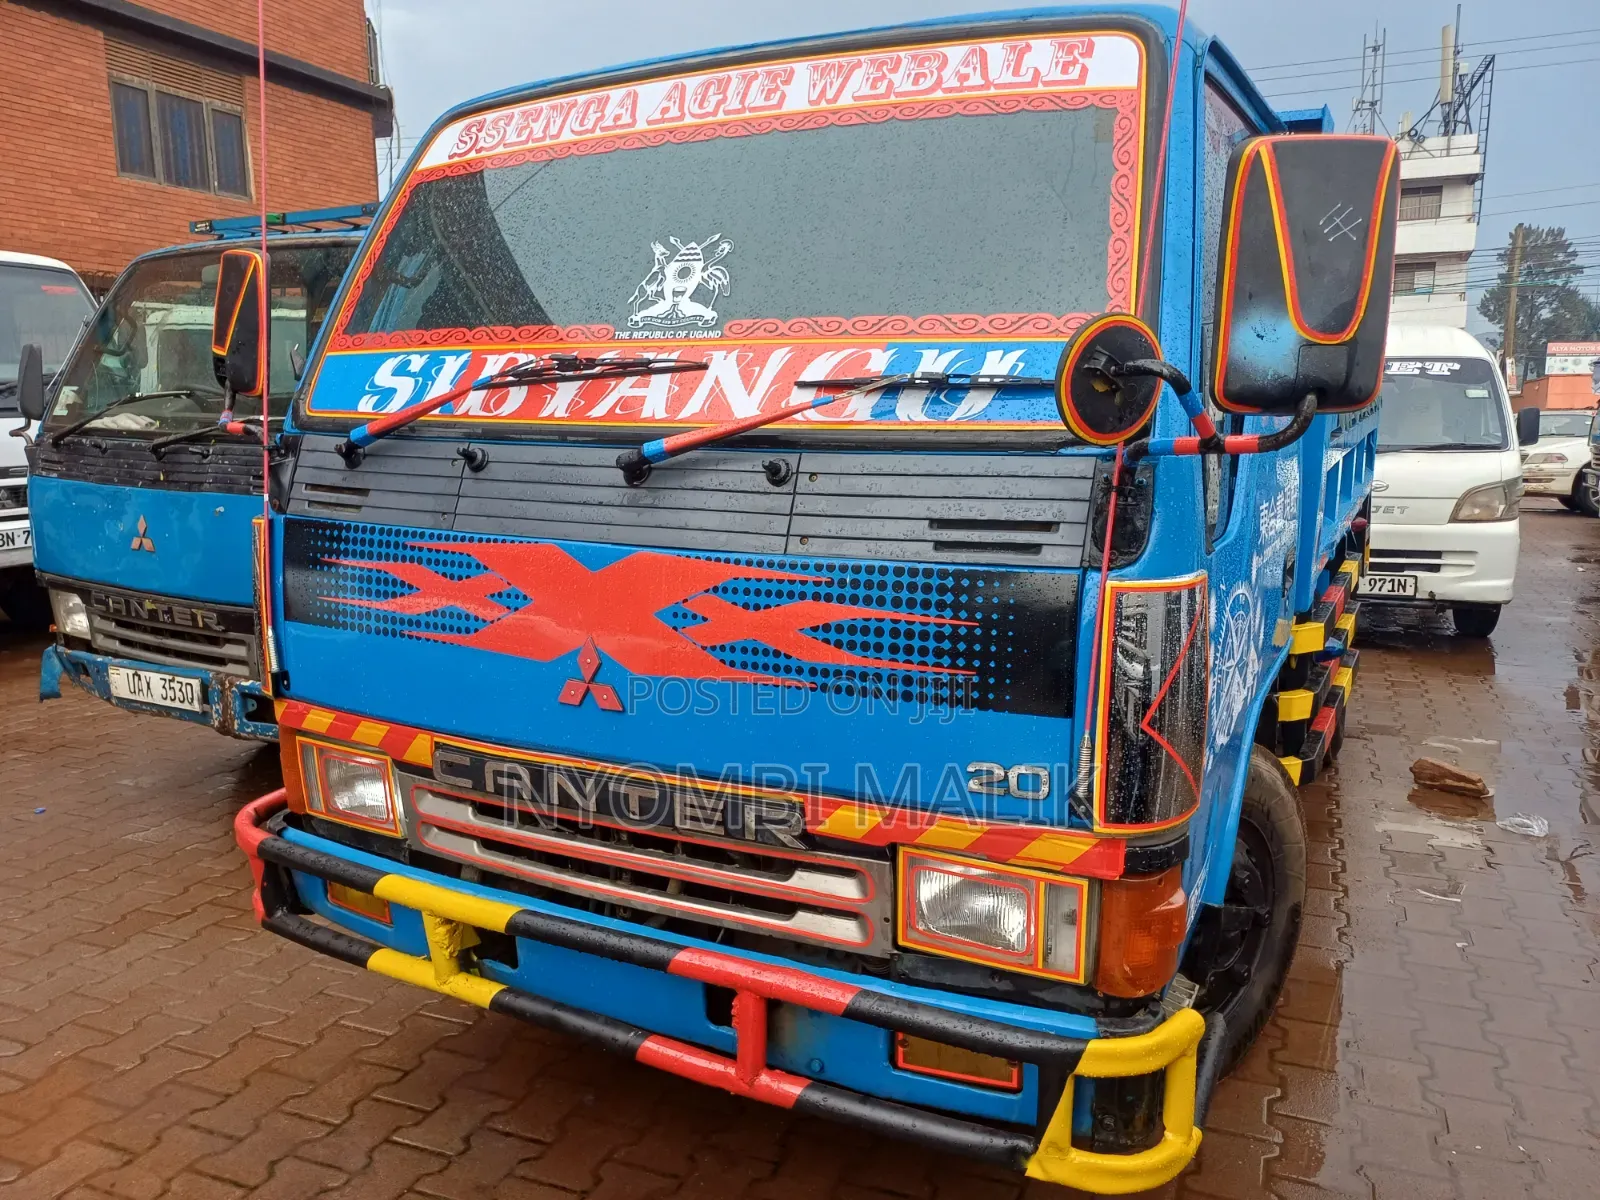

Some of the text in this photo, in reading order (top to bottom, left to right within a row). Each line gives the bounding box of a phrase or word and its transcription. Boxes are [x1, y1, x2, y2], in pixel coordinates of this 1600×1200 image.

[448, 37, 1095, 160] SSENGA AGIE WEBALE
[614, 331, 630, 339] THE
[631, 331, 675, 339] REPUBLIC
[675, 330, 688, 339] OF
[1368, 578, 1407, 593] 971N
[90, 589, 226, 632] CANTER
[126, 672, 154, 699] UAX
[967, 761, 1050, 800] 20
[432, 750, 809, 851] CANTER
